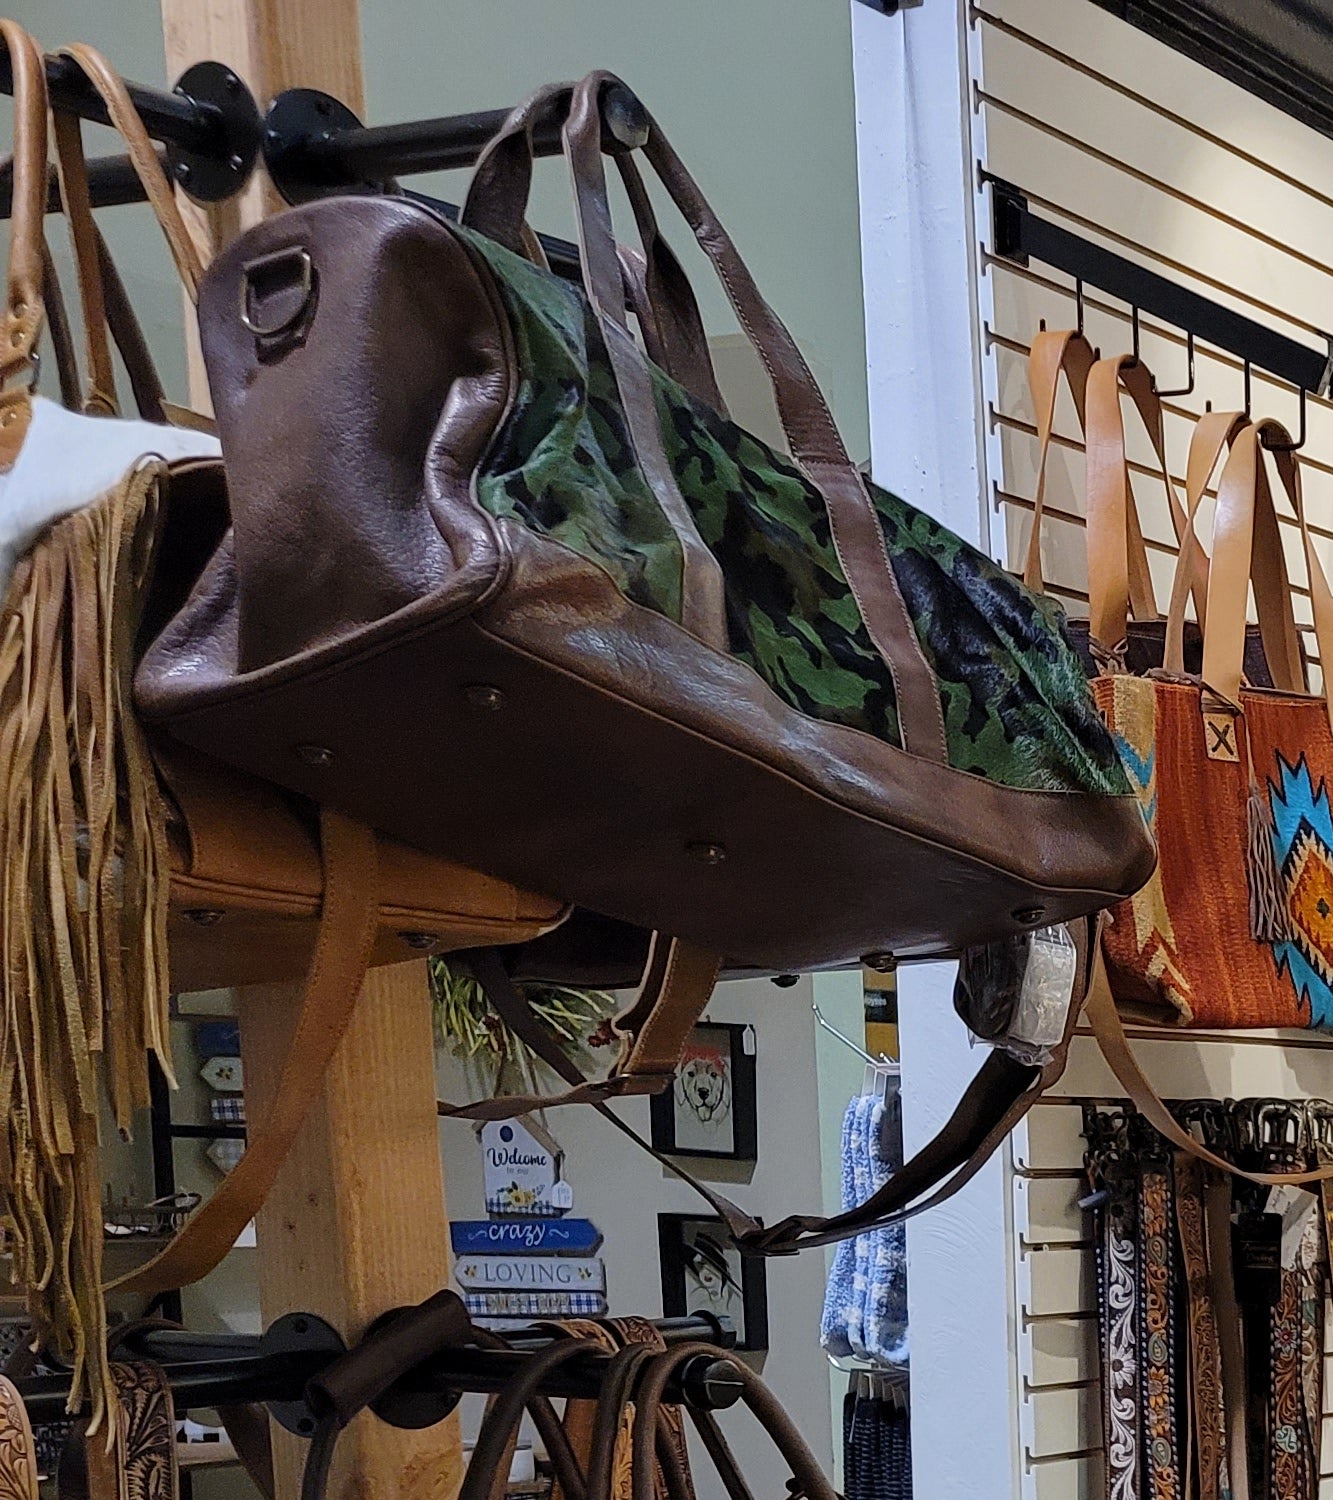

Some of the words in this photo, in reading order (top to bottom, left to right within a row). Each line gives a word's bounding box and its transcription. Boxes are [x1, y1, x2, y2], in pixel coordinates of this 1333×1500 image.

[487, 1147, 547, 1167] Welcome
[489, 1222, 547, 1246] crazy
[485, 1263, 572, 1284] LOVING
